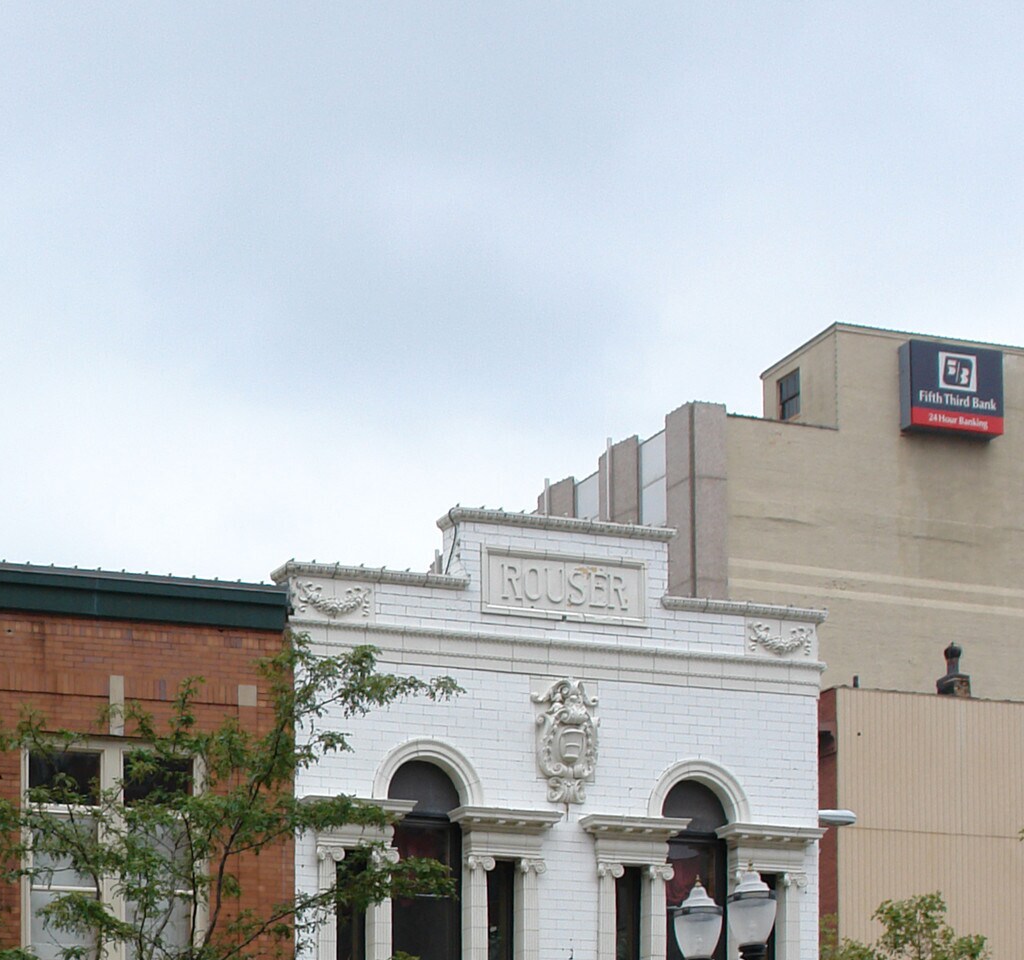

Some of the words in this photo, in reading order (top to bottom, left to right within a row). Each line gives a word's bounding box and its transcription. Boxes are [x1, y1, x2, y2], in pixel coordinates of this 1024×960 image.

[919, 390, 943, 404] Fifth
[944, 393, 970, 408] Third
[972, 397, 997, 411] Bank
[928, 412, 938, 422] 24
[938, 413, 957, 424] Hour
[959, 416, 989, 431] Banking
[500, 563, 629, 611] ROUSER
